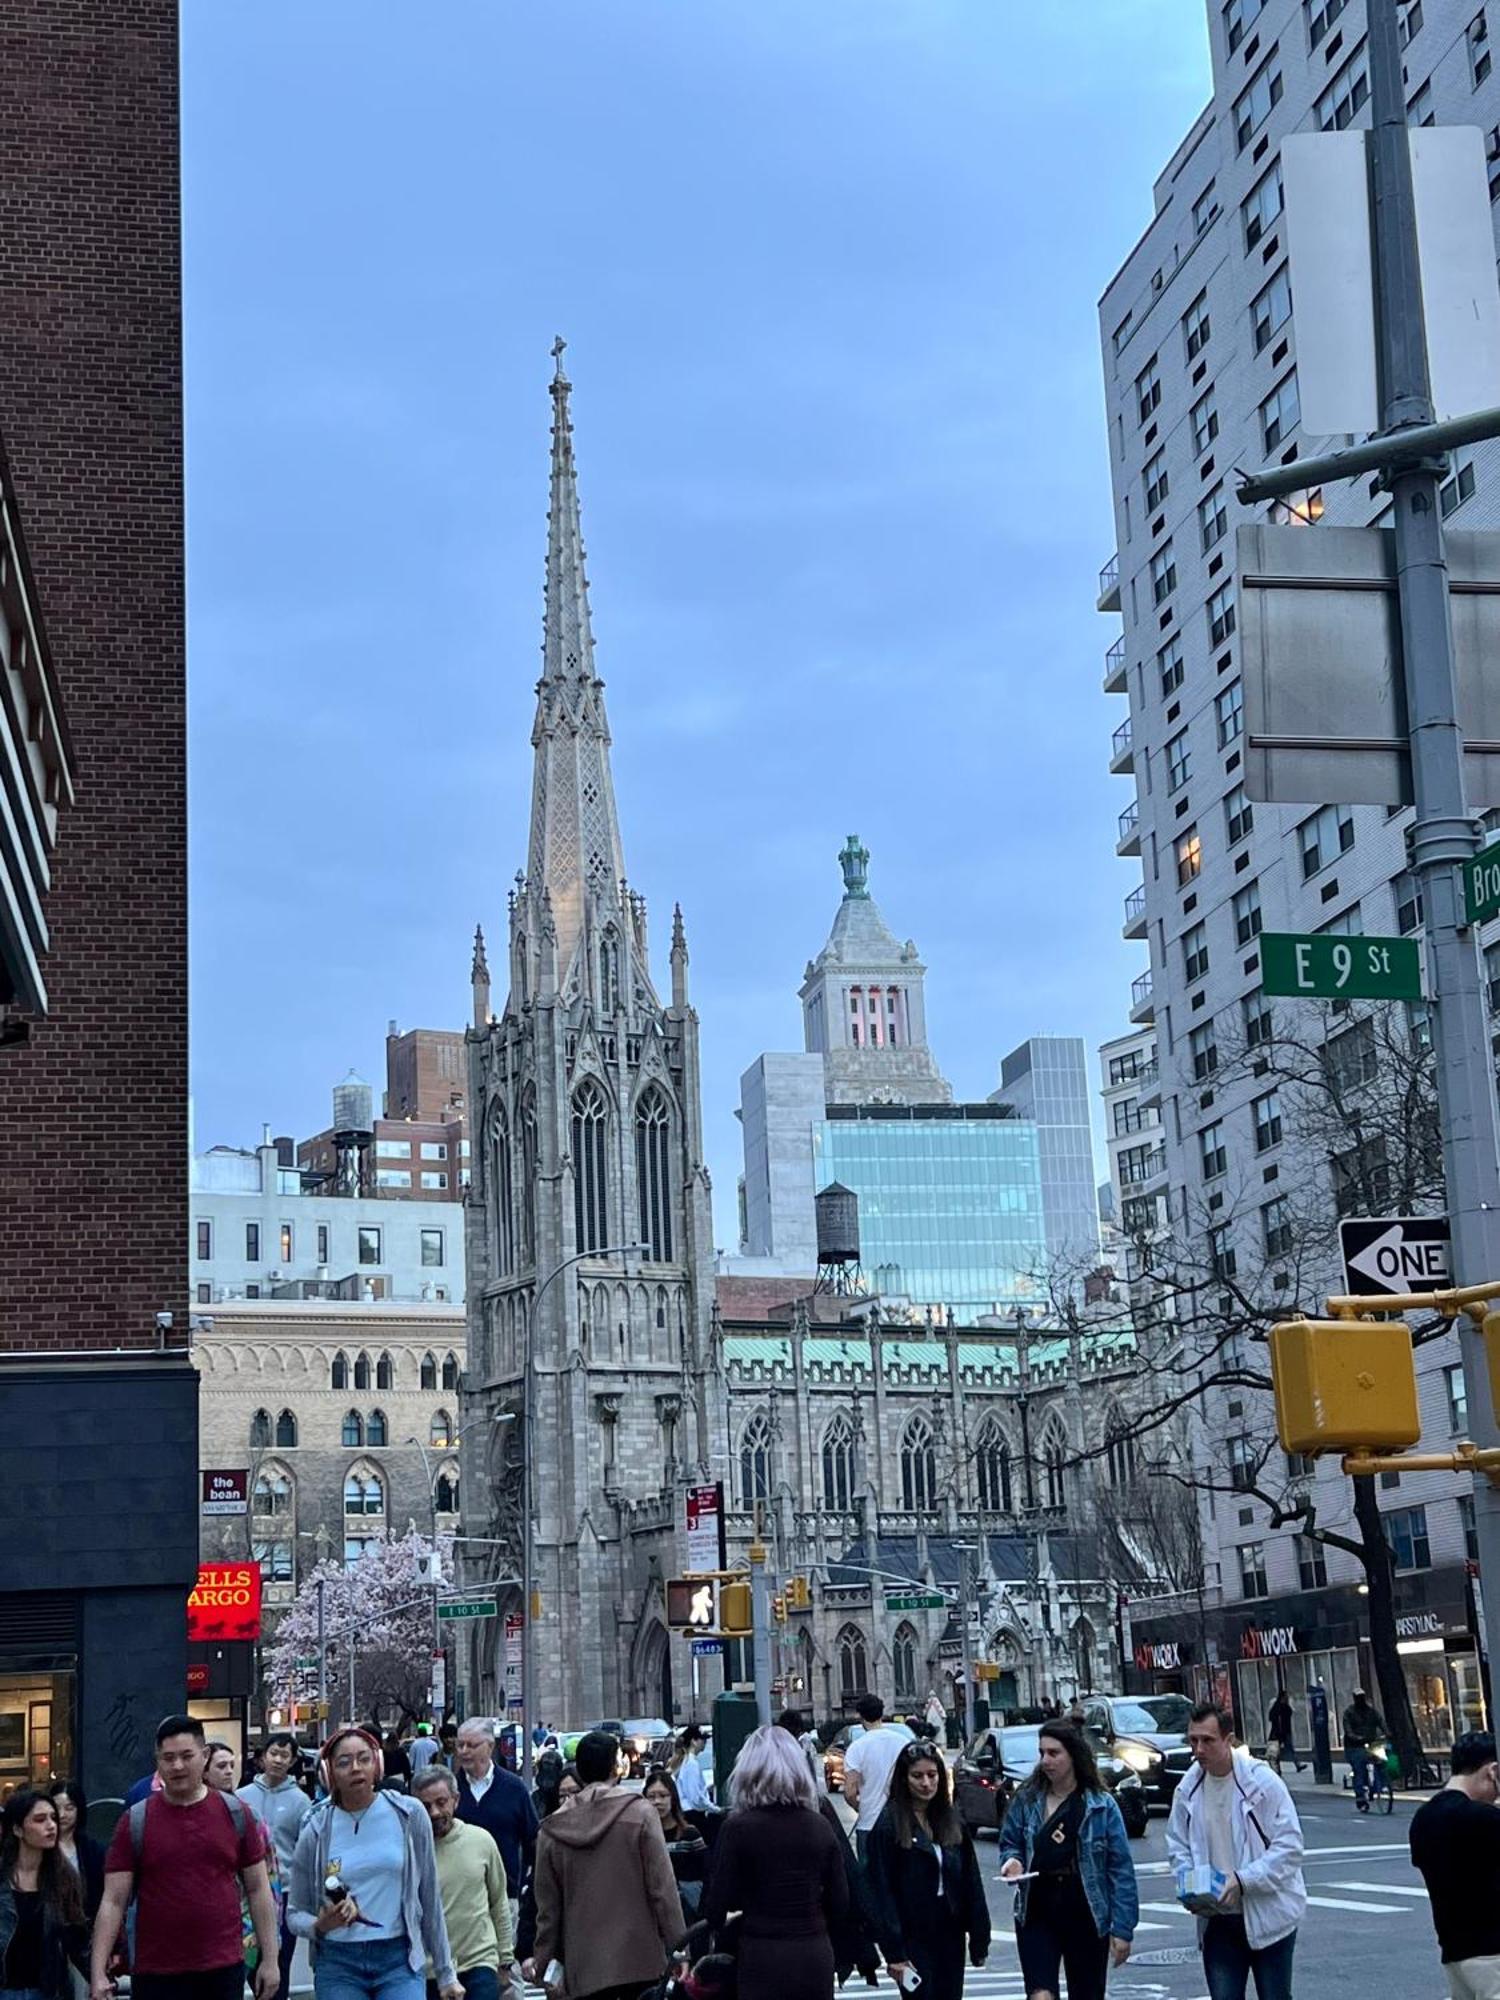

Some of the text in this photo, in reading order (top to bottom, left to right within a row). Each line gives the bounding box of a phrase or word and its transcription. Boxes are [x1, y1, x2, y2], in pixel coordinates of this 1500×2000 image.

[1473, 863, 1500, 907] Bro
[1295, 943, 1391, 988] E 9 St
[1376, 1244, 1448, 1278] ONE
[213, 1477, 234, 1488] the
[210, 1489, 240, 1500] bean
[908, 1598, 918, 1607] 10
[920, 1598, 929, 1607] St
[457, 1606, 467, 1615] 10
[471, 1604, 480, 1616] St
